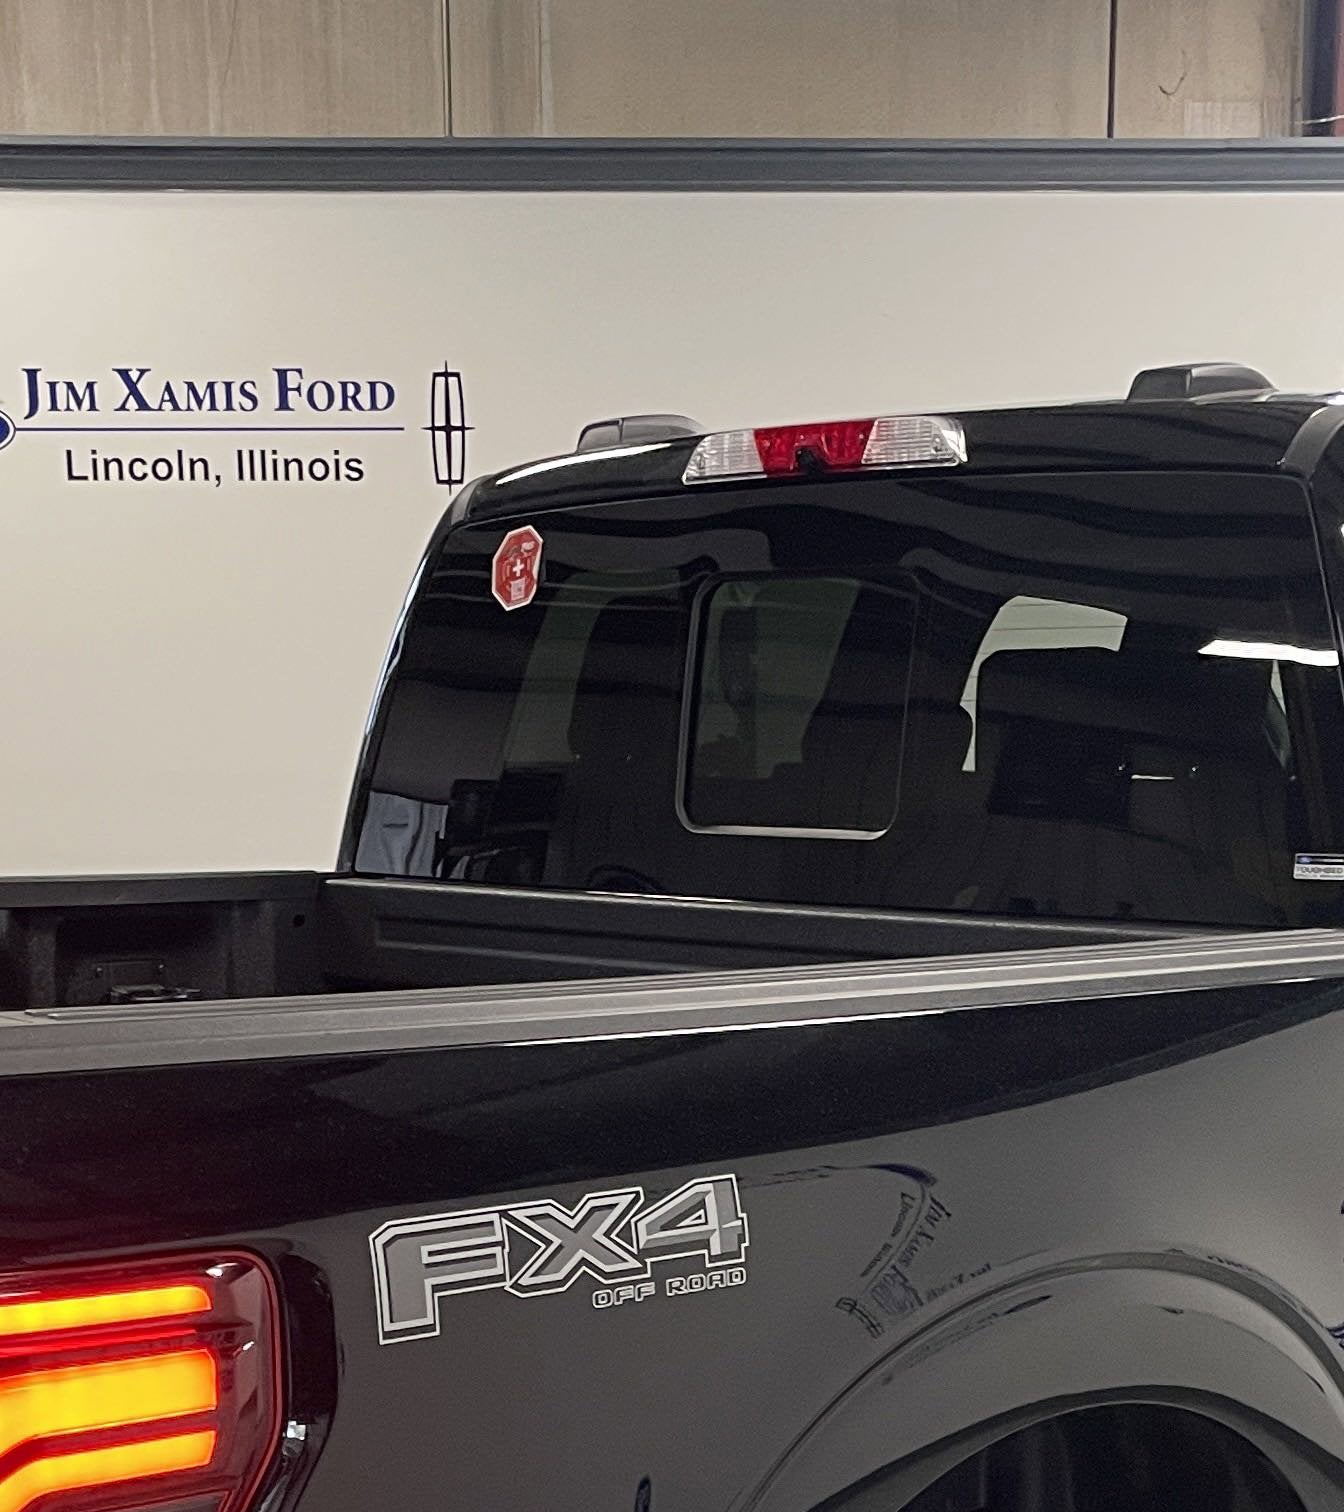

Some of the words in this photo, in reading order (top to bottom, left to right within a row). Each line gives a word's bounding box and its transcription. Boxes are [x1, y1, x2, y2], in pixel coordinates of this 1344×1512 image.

[20, 367, 99, 413] JIM
[112, 368, 258, 413] XAMIS
[272, 367, 396, 413] FORD
[64, 449, 222, 487] Lincoln,
[236, 449, 365, 483] Illinois
[368, 1173, 750, 1345] FX4
[592, 1283, 656, 1309] OFF
[665, 1266, 747, 1297] ROAD
